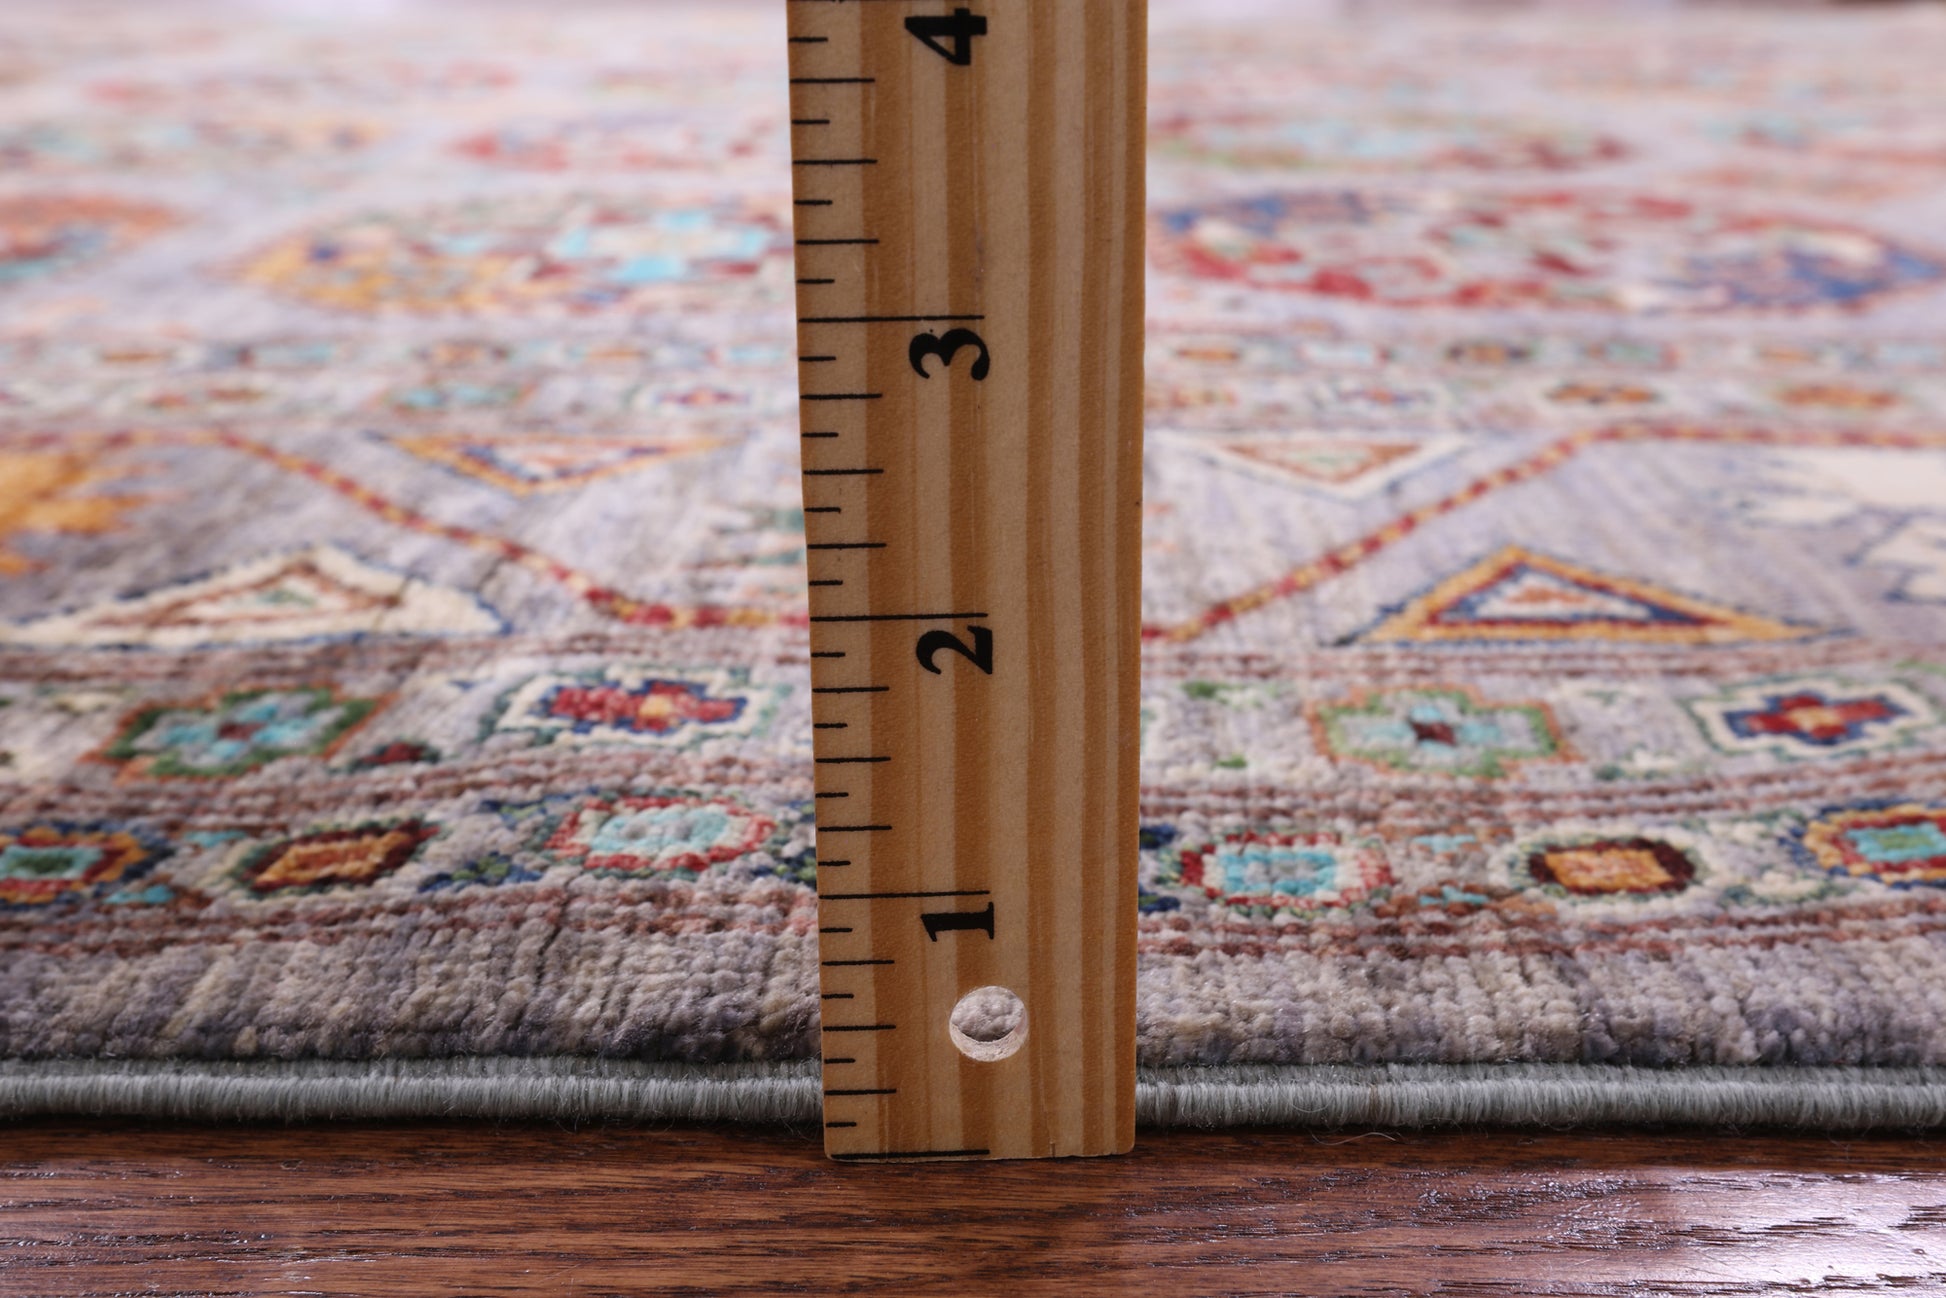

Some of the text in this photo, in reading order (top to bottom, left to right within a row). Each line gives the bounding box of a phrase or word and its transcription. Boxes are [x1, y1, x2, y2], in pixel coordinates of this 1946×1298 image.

[904, 7, 988, 66] 4
[908, 327, 991, 382] 3
[915, 625, 993, 675] 2
[919, 901, 995, 943] 1
